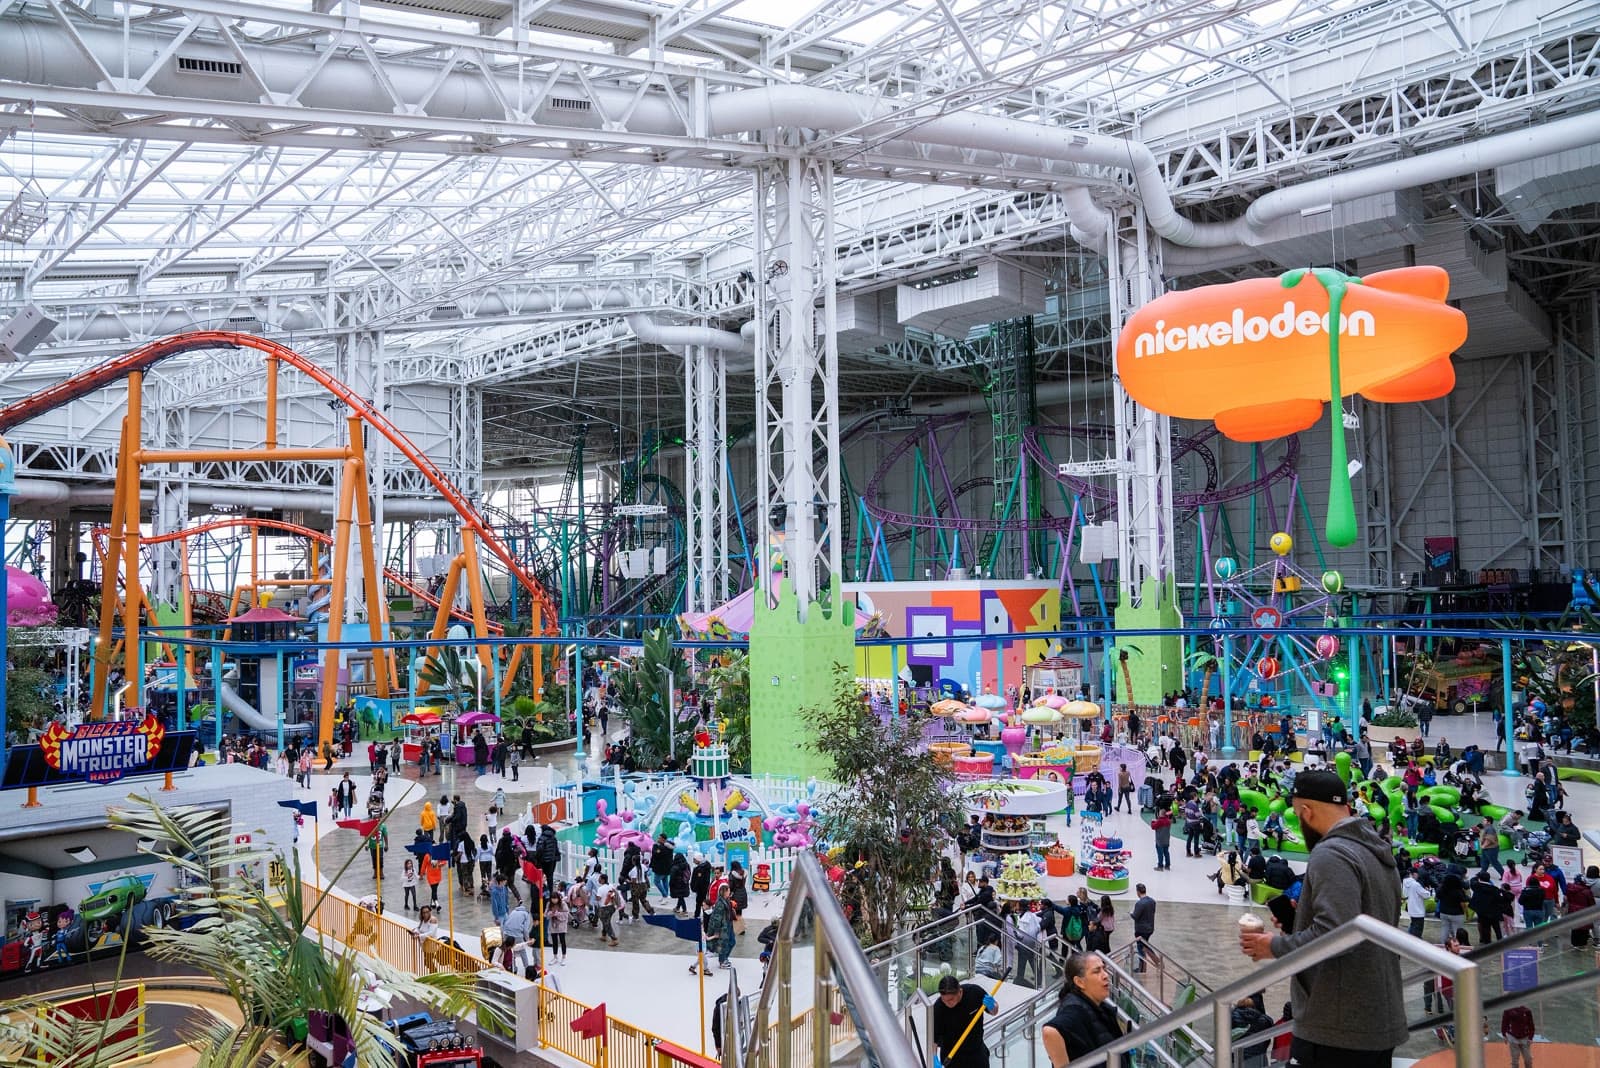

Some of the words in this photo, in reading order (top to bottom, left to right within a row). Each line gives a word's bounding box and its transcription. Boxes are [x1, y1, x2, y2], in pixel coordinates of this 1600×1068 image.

[1135, 301, 1376, 358] nickelodeon
[62, 734, 146, 771] MONSTER
[78, 753, 134, 772] TRUCK
[90, 770, 121, 781] RALLY
